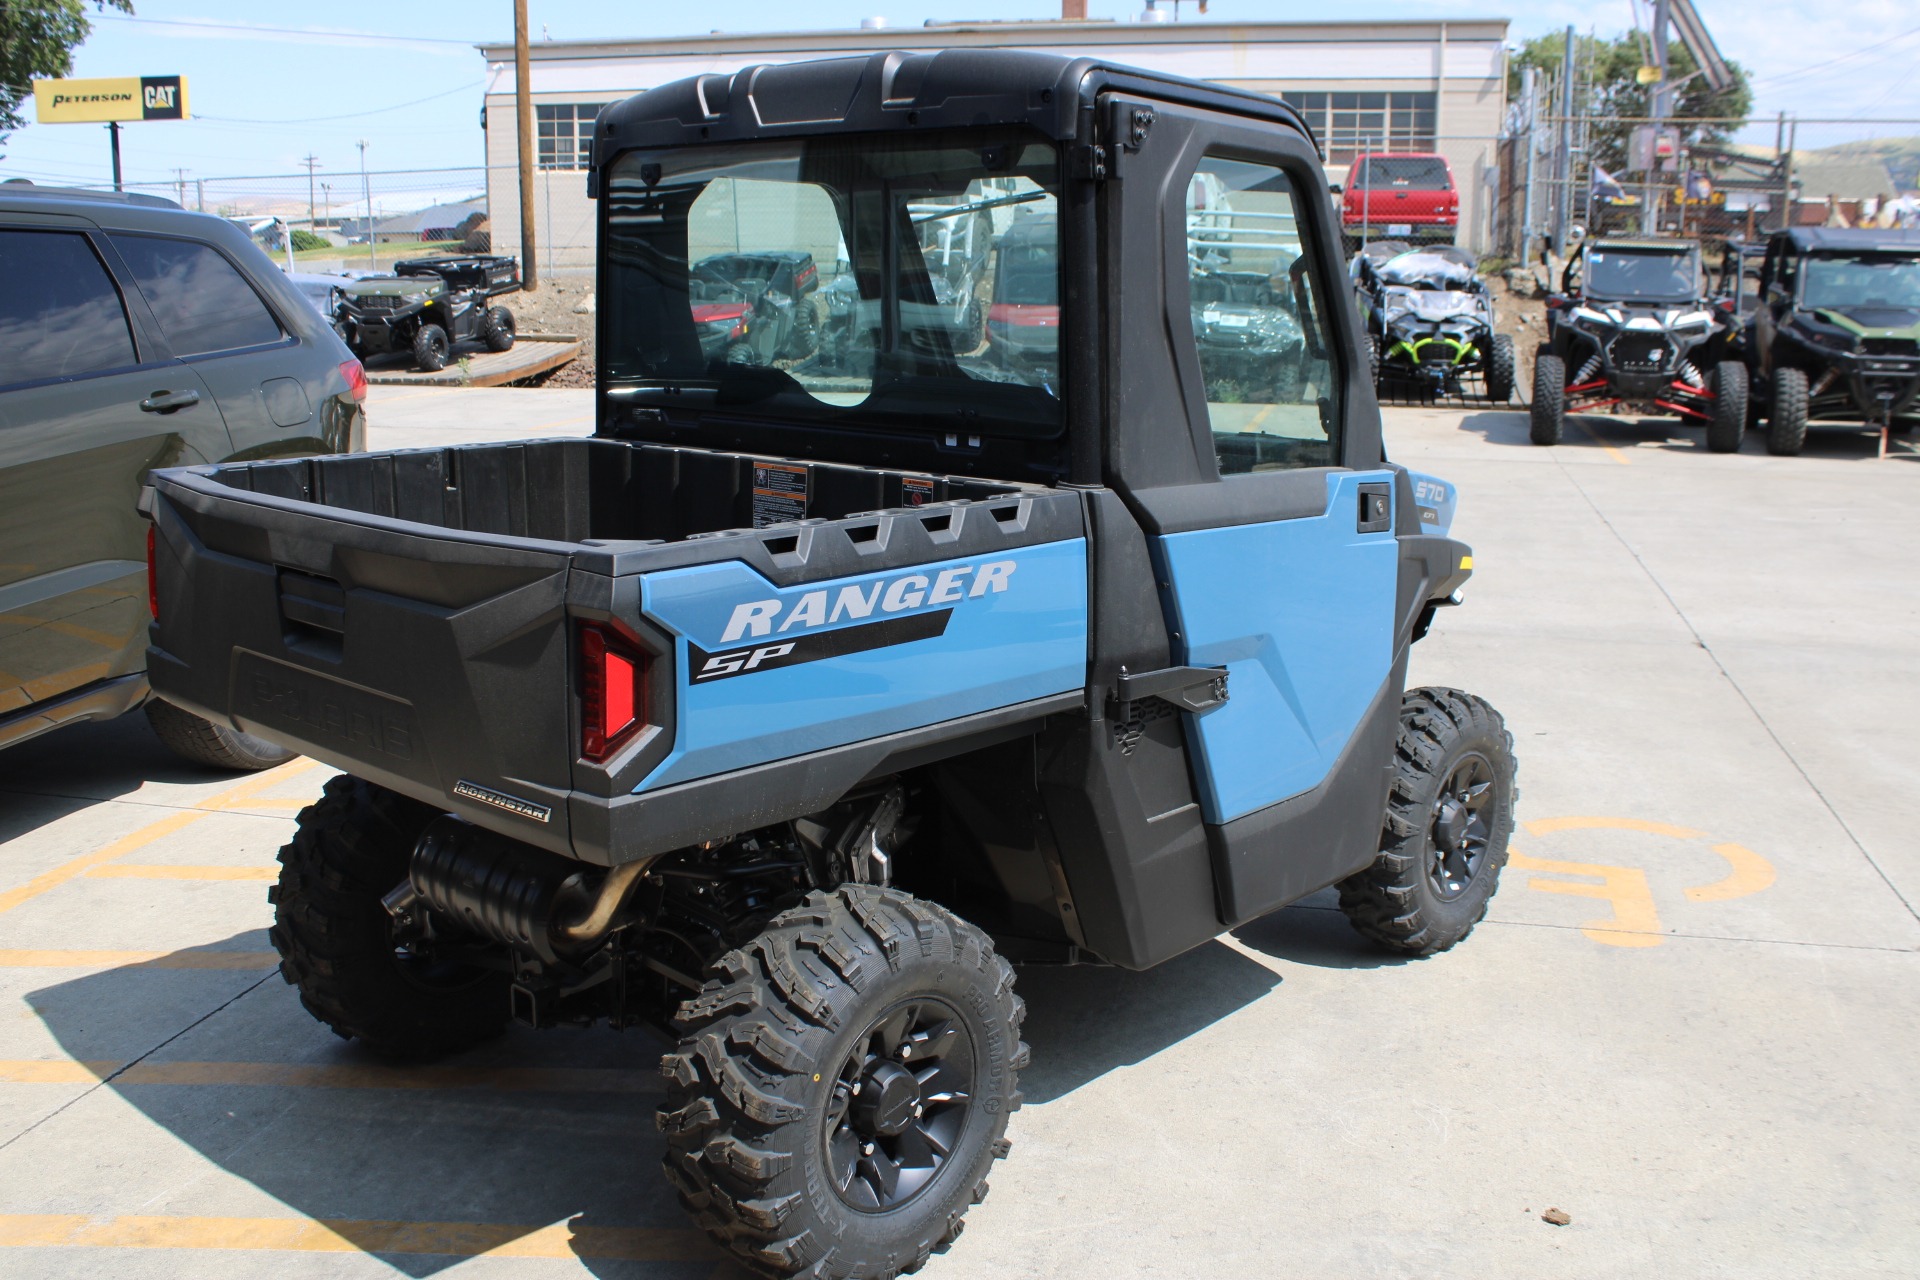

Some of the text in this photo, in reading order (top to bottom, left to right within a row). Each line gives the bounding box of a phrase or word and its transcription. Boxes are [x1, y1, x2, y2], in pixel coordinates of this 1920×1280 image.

[52, 85, 176, 109] PETERSON CAT
[1415, 481, 1445, 502] 570
[720, 560, 1017, 644] RANGER
[696, 643, 797, 680] SP
[458, 783, 546, 819] NORTHSTAR
